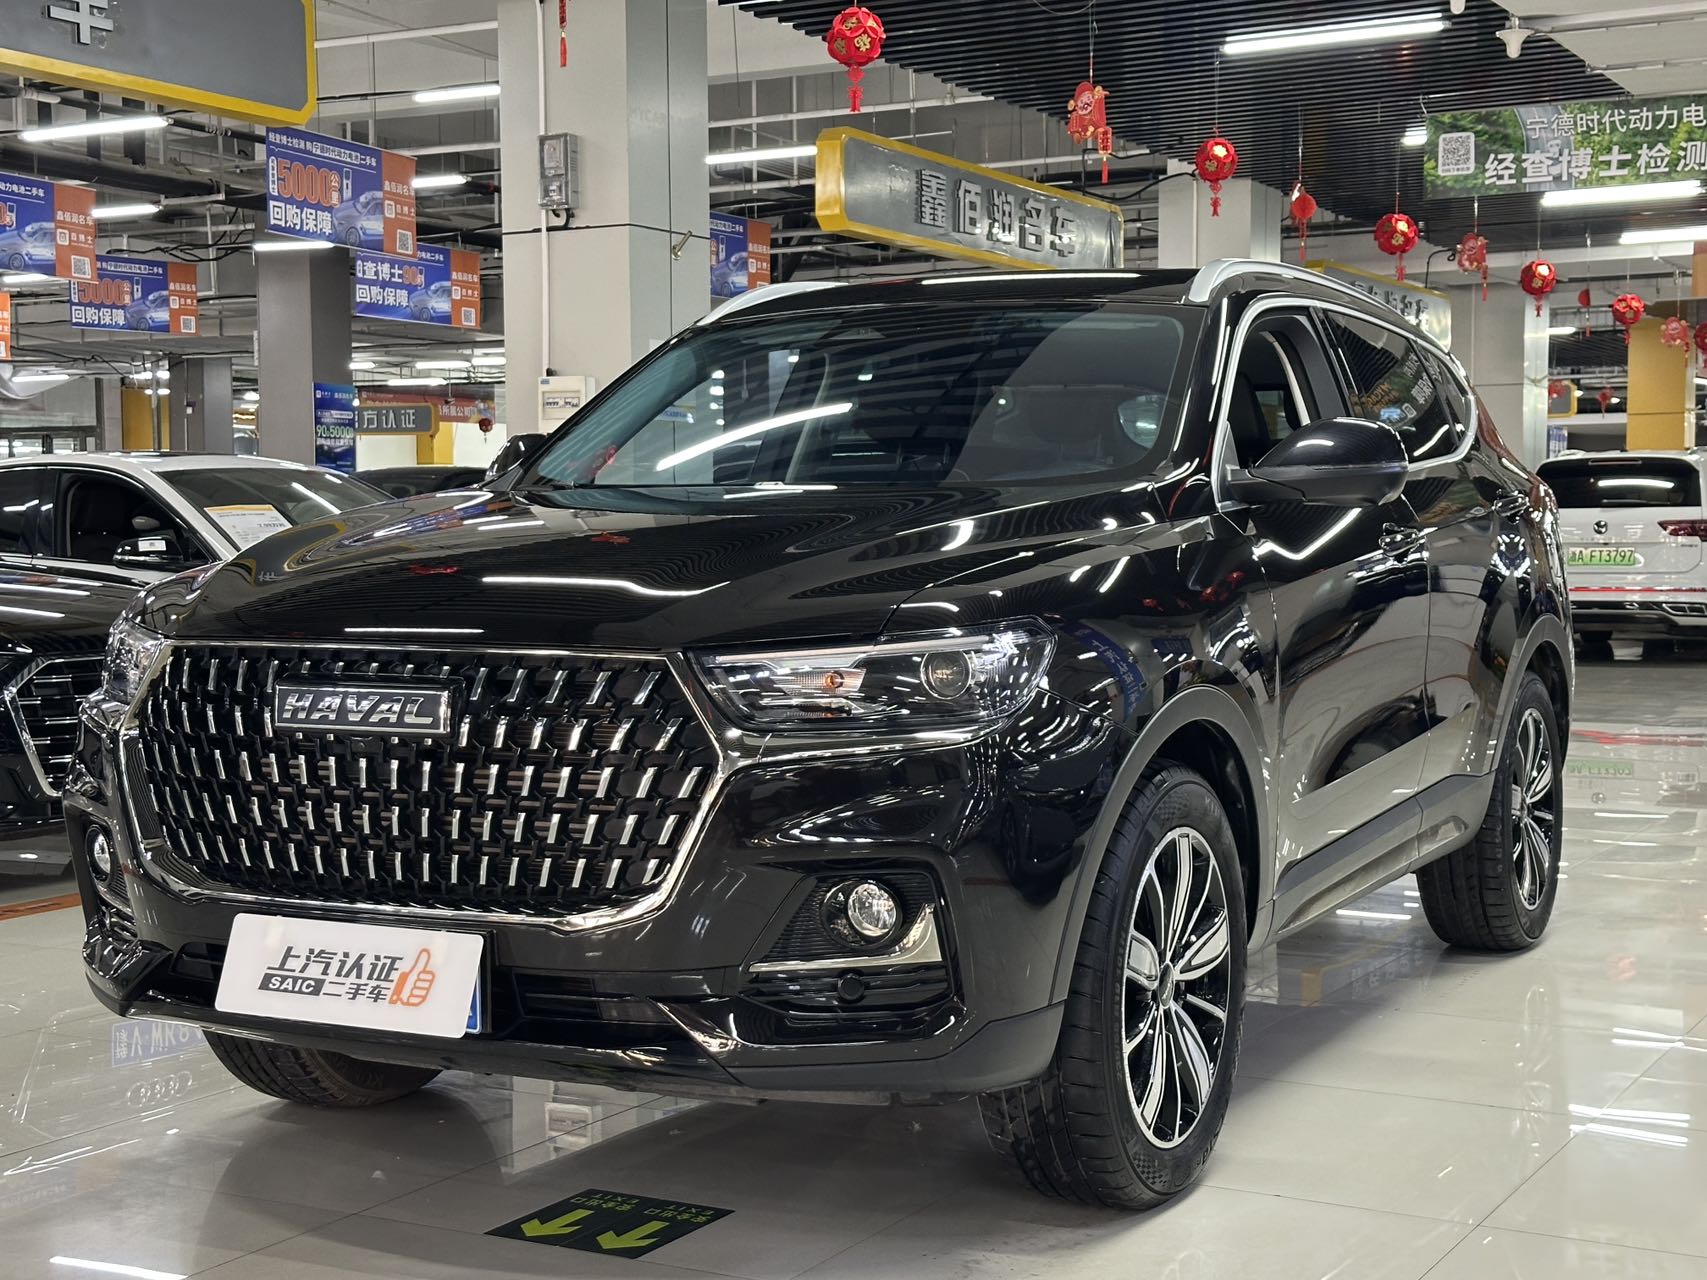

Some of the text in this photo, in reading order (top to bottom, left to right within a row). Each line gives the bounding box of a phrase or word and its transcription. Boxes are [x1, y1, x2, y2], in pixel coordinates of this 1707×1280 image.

[1484, 141, 1707, 186] 经查博士检测
[269, 200, 333, 235] 回购保障
[356, 284, 409, 307] 回购保障
[72, 306, 126, 326] 回购保障
[282, 693, 434, 724] HAVAL
[267, 946, 404, 983] 上汽认证
[268, 976, 316, 993] SAIC
[322, 981, 393, 1003] 二手车
[570, 1197, 635, 1212] 安全出口
[591, 1193, 640, 1204] EXIT
[643, 1207, 711, 1223] 安全出口
[665, 1204, 716, 1215] EXIT
